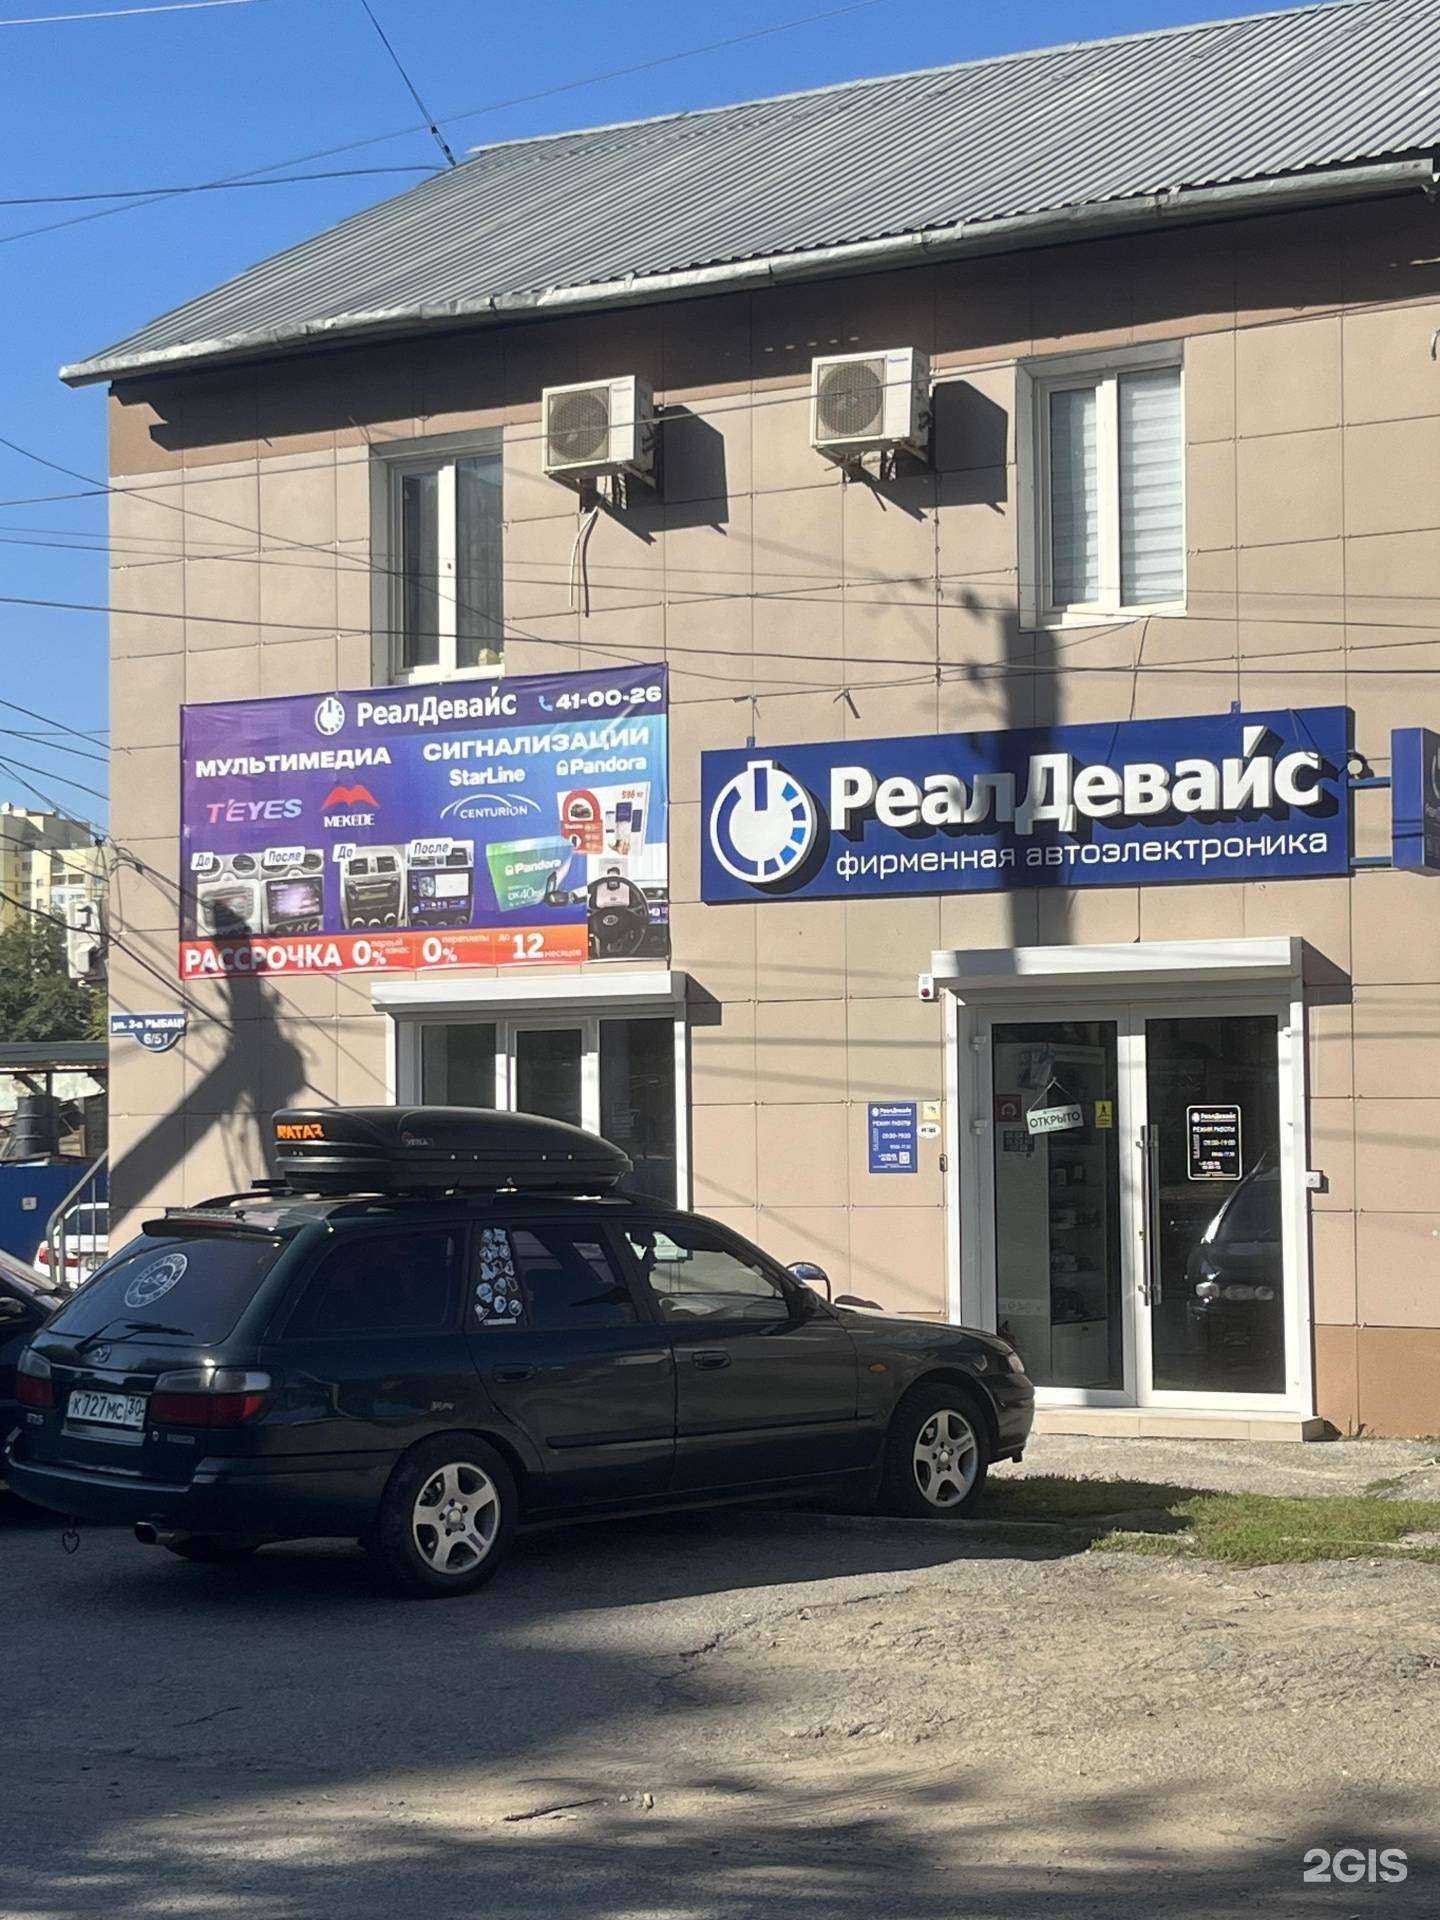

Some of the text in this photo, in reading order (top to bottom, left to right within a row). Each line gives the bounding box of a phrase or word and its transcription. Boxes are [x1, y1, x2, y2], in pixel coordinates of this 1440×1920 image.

[357, 686, 517, 727] РеалДевайс
[555, 686, 662, 709] 41-00-26
[423, 727, 650, 761] СИГНАЛИЗАЦИИ
[196, 747, 391, 778] МУЛЬТИМЕДИА
[570, 755, 647, 776] Pandora
[449, 766, 526, 787] StarLine
[829, 725, 1321, 835] РеалДевайс
[460, 806, 528, 820] CENTURION
[267, 850, 301, 863] После
[413, 841, 450, 855] После
[835, 832, 1328, 877] фирменная автоэлектроника
[512, 932, 545, 960] 12
[185, 943, 342, 973] РАССРОЧКА
[143, 1033, 168, 1044] 6/51
[1030, 1111, 1080, 1128] ОТКРЫТО
